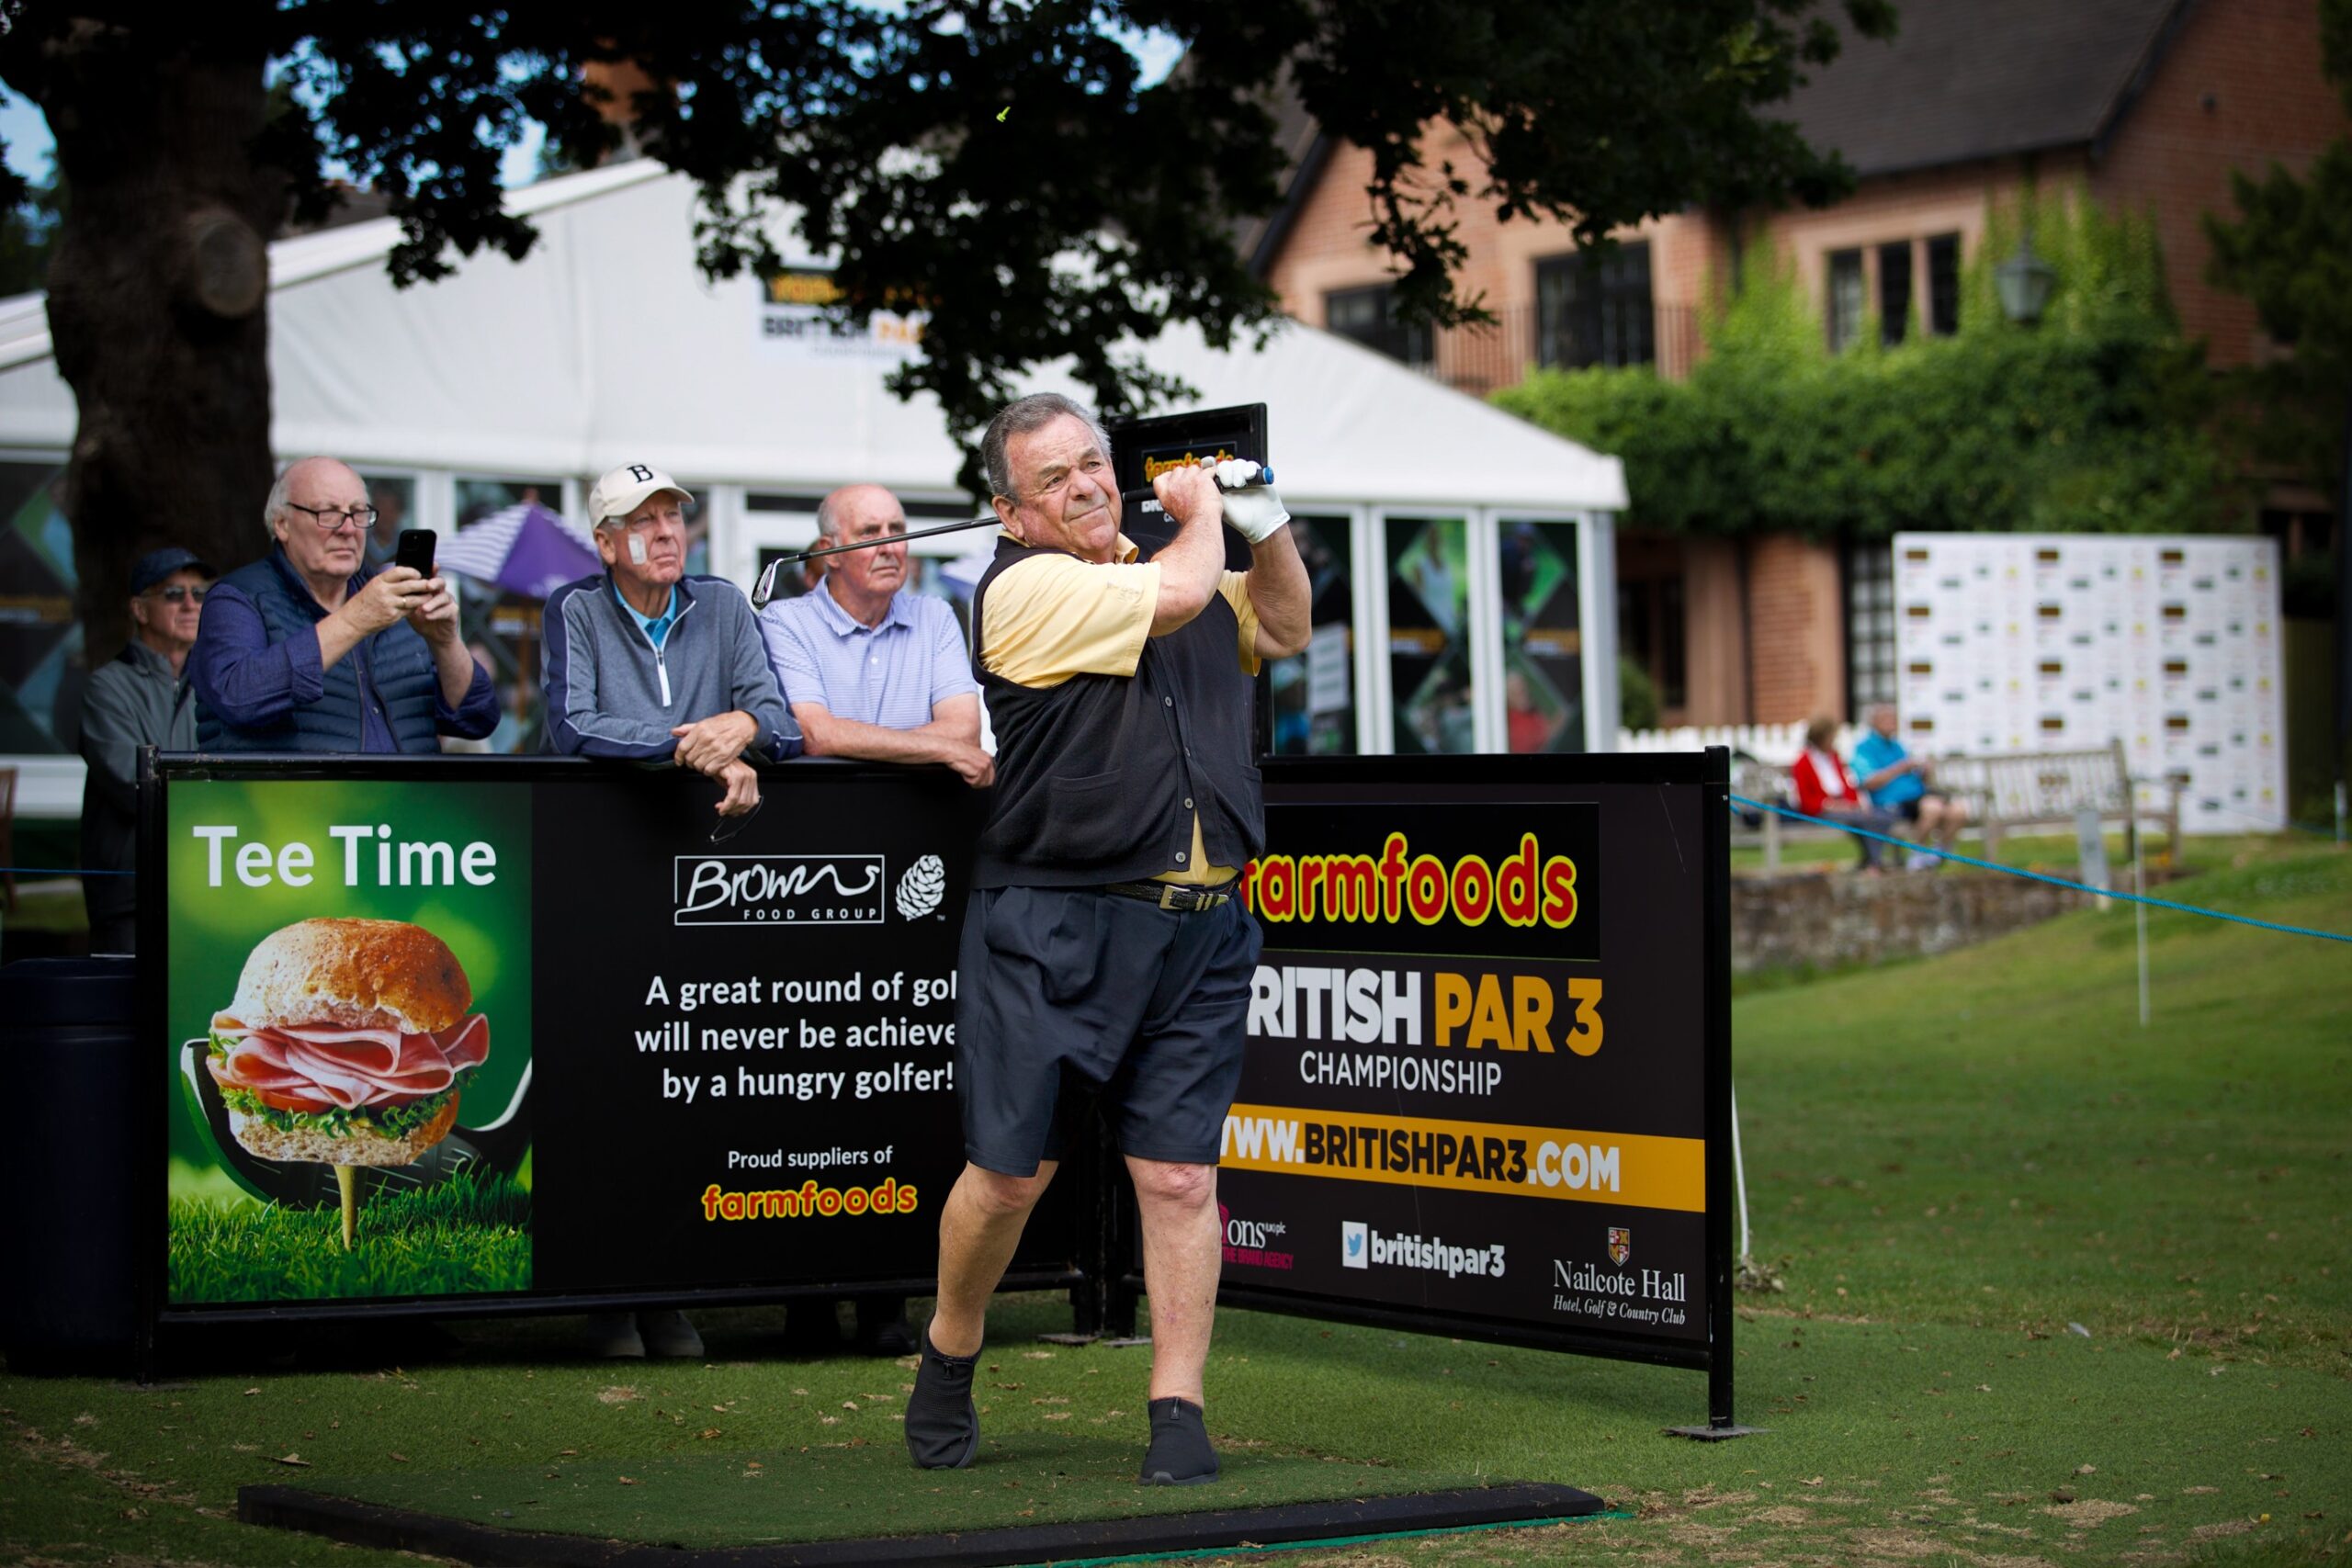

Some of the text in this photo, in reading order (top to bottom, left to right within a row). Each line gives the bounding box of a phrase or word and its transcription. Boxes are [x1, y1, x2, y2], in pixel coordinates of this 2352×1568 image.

[627, 464, 653, 485] B
[192, 823, 497, 887] Tee Time
[743, 908, 876, 920] FOOD GROUP
[645, 970, 957, 1011] A great round of gol
[1246, 965, 1604, 1056] RITISH PAR 3
[634, 1016, 956, 1053] will never be achieve
[662, 1061, 954, 1103] by a hungry golfer!
[1299, 1050, 1502, 1096] CHAMPIONSHIP
[728, 1145, 893, 1169] Proud suppliers of
[701, 1177, 918, 1222] farmfoods
[1371, 1229, 1506, 1279] britishpar3
[1553, 1258, 1687, 1303] Nailcote Hall
[1553, 1293, 1686, 1325] Hotel, Golf & Country Club
